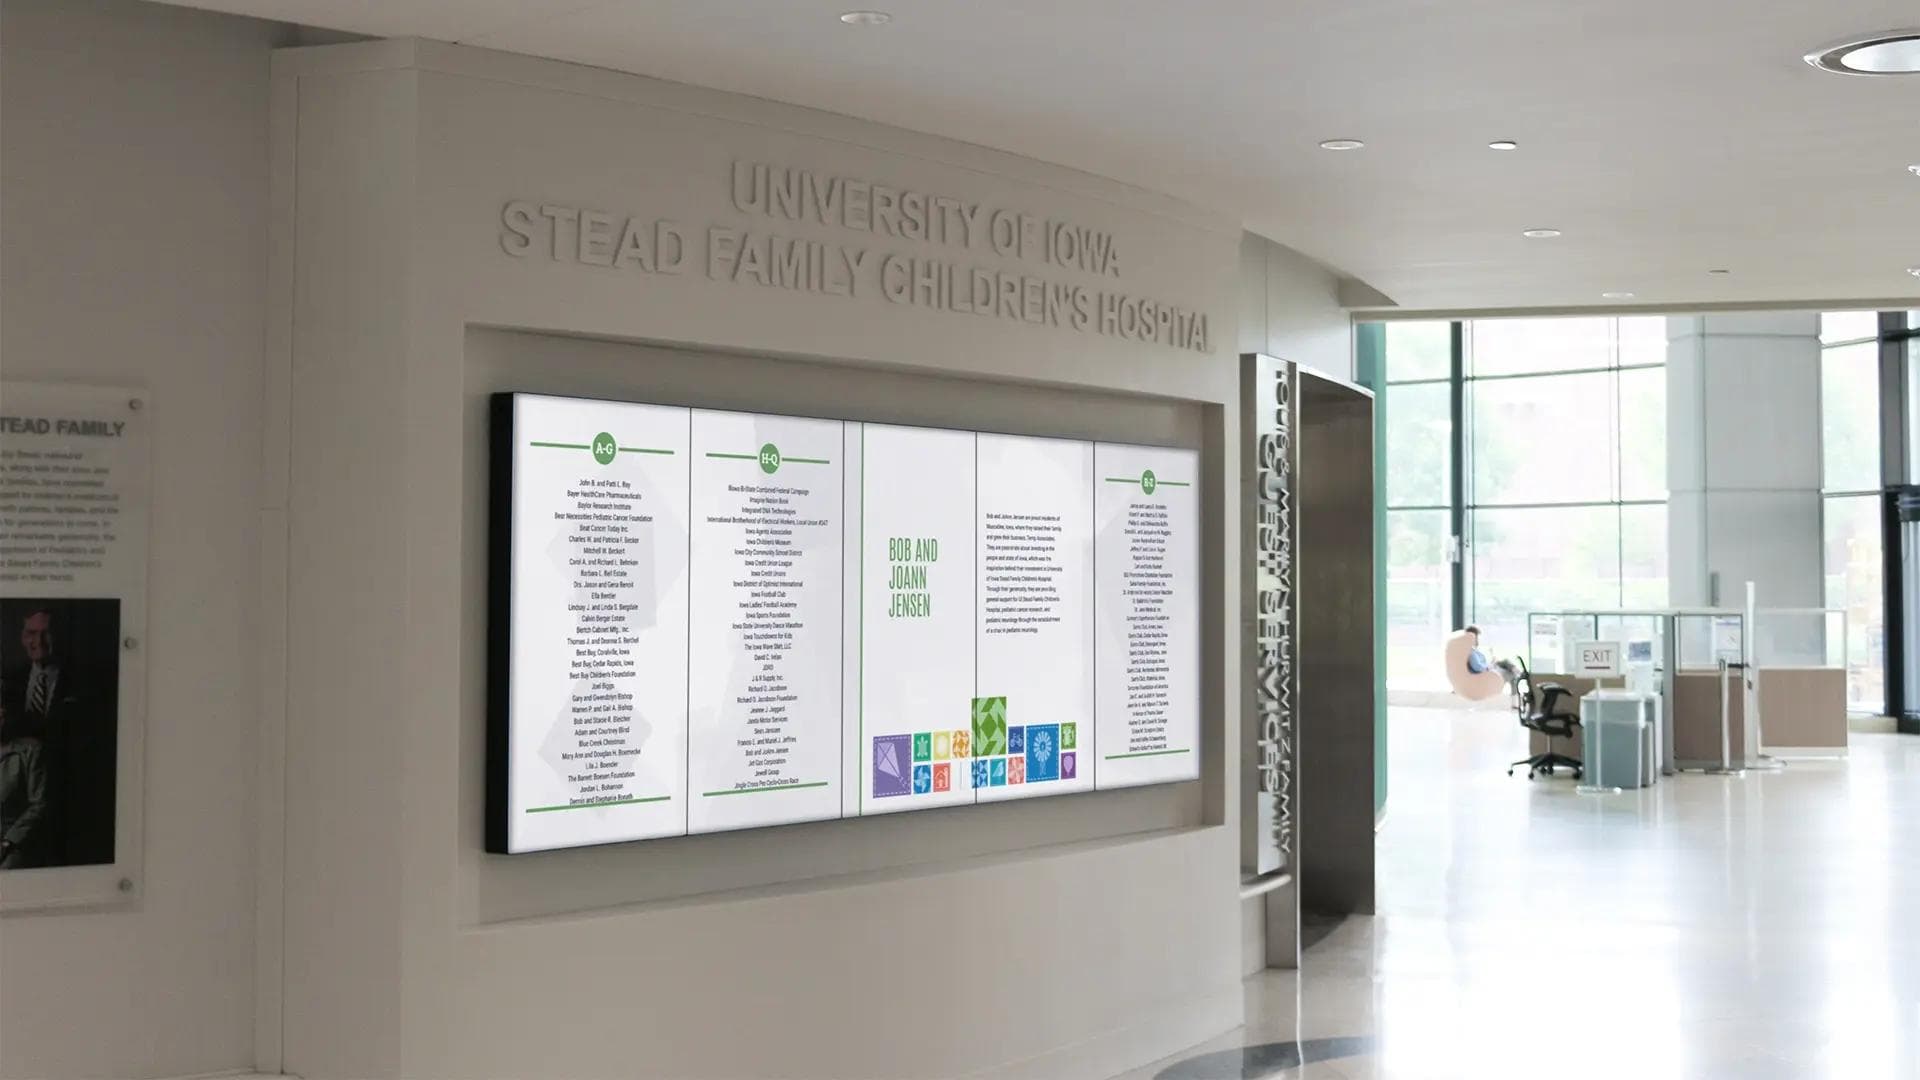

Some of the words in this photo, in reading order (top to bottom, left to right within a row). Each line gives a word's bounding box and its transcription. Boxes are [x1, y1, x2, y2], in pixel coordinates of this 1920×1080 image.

[729, 160, 979, 249] UNIVERSITY
[988, 208, 1035, 259] OF
[1044, 219, 1121, 278] IOWA
[500, 200, 684, 276] STEAD
[706, 225, 865, 297] FAMILY
[880, 253, 1089, 332] CHILDREN'S
[1097, 291, 1215, 353] HOSPITAL
[56, 419, 126, 437] FAMILY
[595, 442, 614, 455] A-G
[761, 452, 778, 466] H-Q
[1259, 432, 1278, 575] GUEST
[889, 537, 911, 562] BOB
[915, 538, 938, 562] AND
[888, 565, 926, 590] JOANN
[888, 593, 930, 618] JENSEN
[1584, 649, 1611, 662] EXIT
[1259, 589, 1281, 793] SERVICES
[1280, 620, 1292, 754] HURWITZ
[610, 770, 635, 778] Foundation
[1280, 759, 1292, 853] FAMILY
